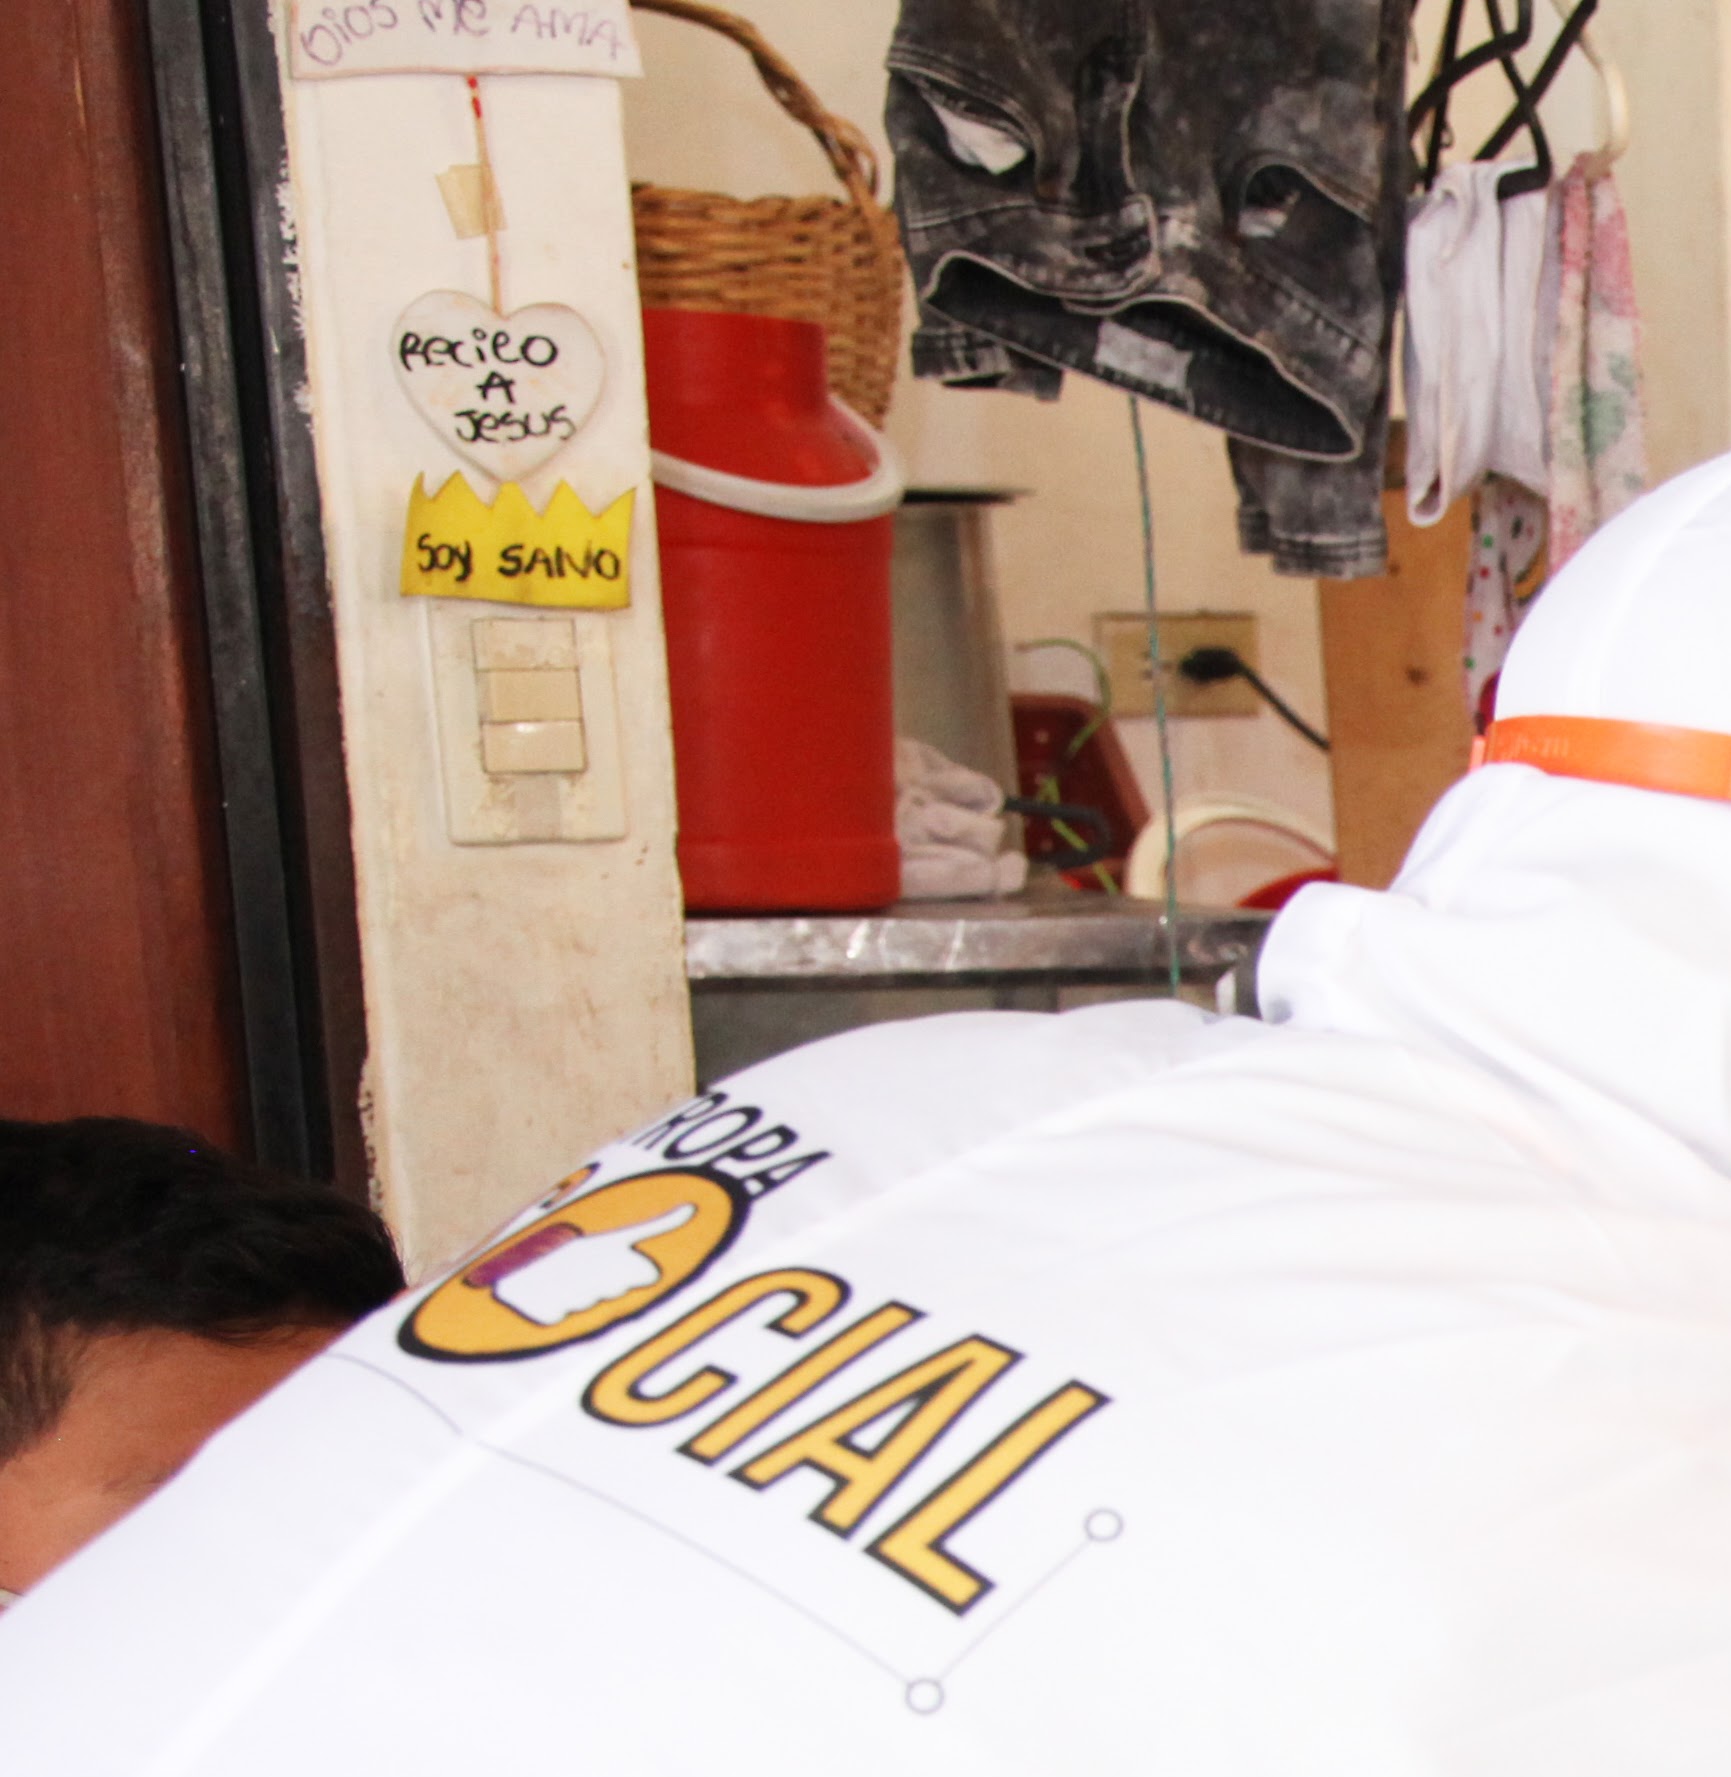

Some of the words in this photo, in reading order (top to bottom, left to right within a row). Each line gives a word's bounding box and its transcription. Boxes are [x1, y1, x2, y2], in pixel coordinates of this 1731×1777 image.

[511, 4, 623, 60] AMA
[476, 370, 517, 404] A
[497, 541, 620, 580] SANO
